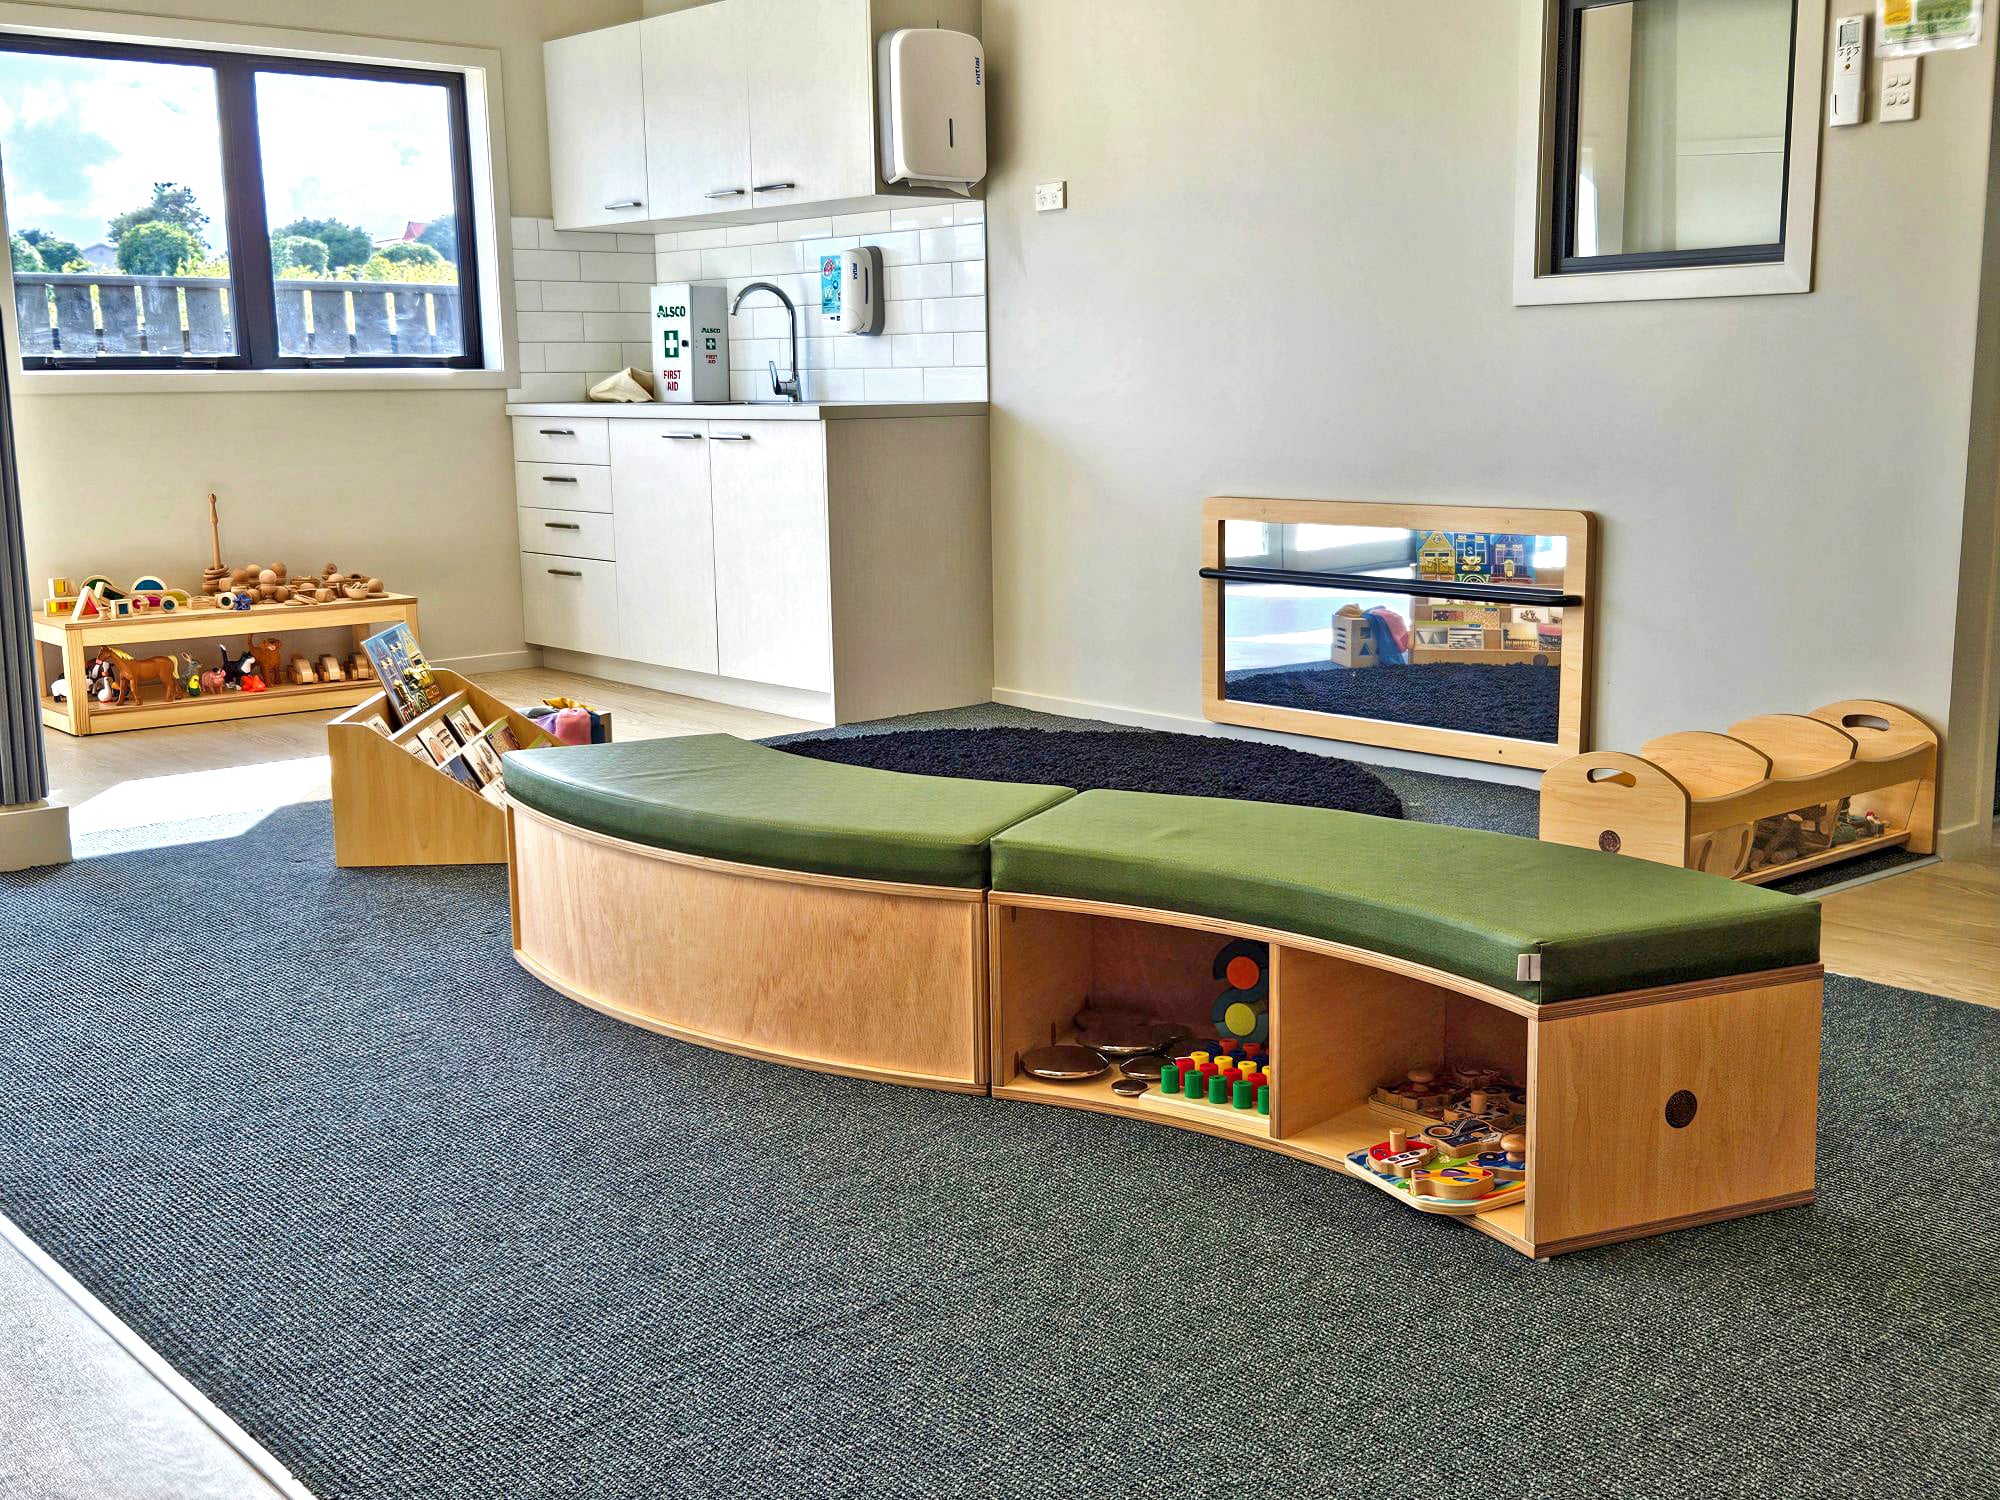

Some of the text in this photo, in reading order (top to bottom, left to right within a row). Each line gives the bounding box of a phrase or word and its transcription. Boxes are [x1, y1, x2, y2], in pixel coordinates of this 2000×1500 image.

[656, 305, 686, 318] ALSCO
[663, 370, 681, 379] FIRST
[667, 381, 679, 391] AID
